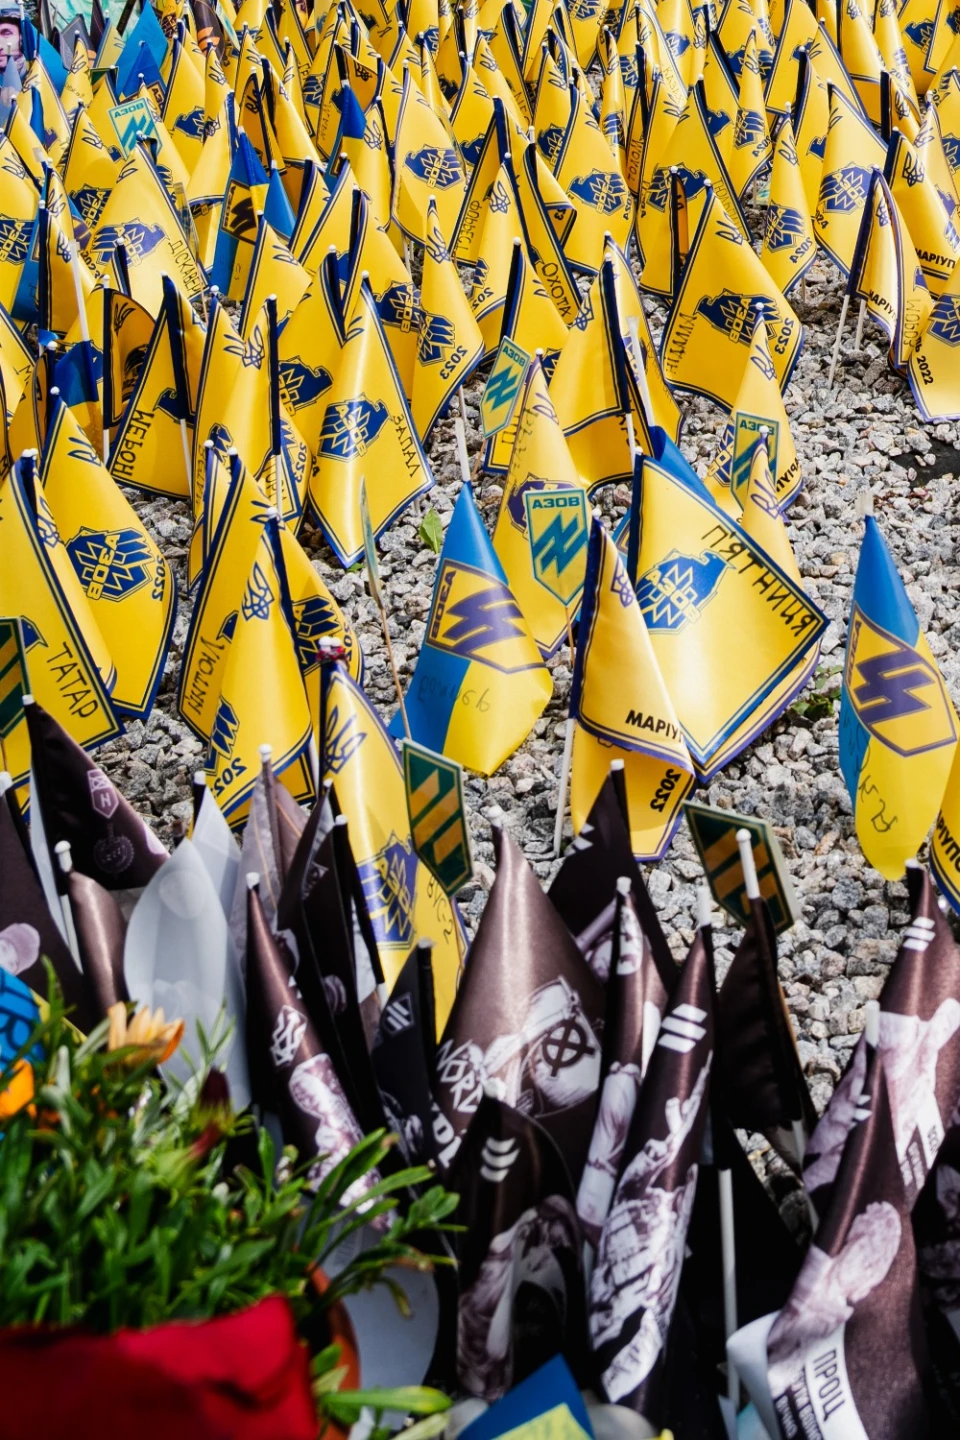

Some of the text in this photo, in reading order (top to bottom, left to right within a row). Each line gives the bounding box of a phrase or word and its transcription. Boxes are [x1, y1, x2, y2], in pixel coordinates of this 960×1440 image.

[113, 102, 145, 118] АЗОВ
[541, 263, 572, 317] ОХОТА
[502, 345, 527, 367] АЗОВ
[335, 404, 367, 458] АЗОВ
[393, 413, 420, 479] ЗАПАЛ
[532, 496, 581, 509] АЗОВ
[648, 569, 700, 625] АЗОВ
[48, 642, 98, 719] ТАТАР
[814, 1348, 845, 1423] ПРОЦ
